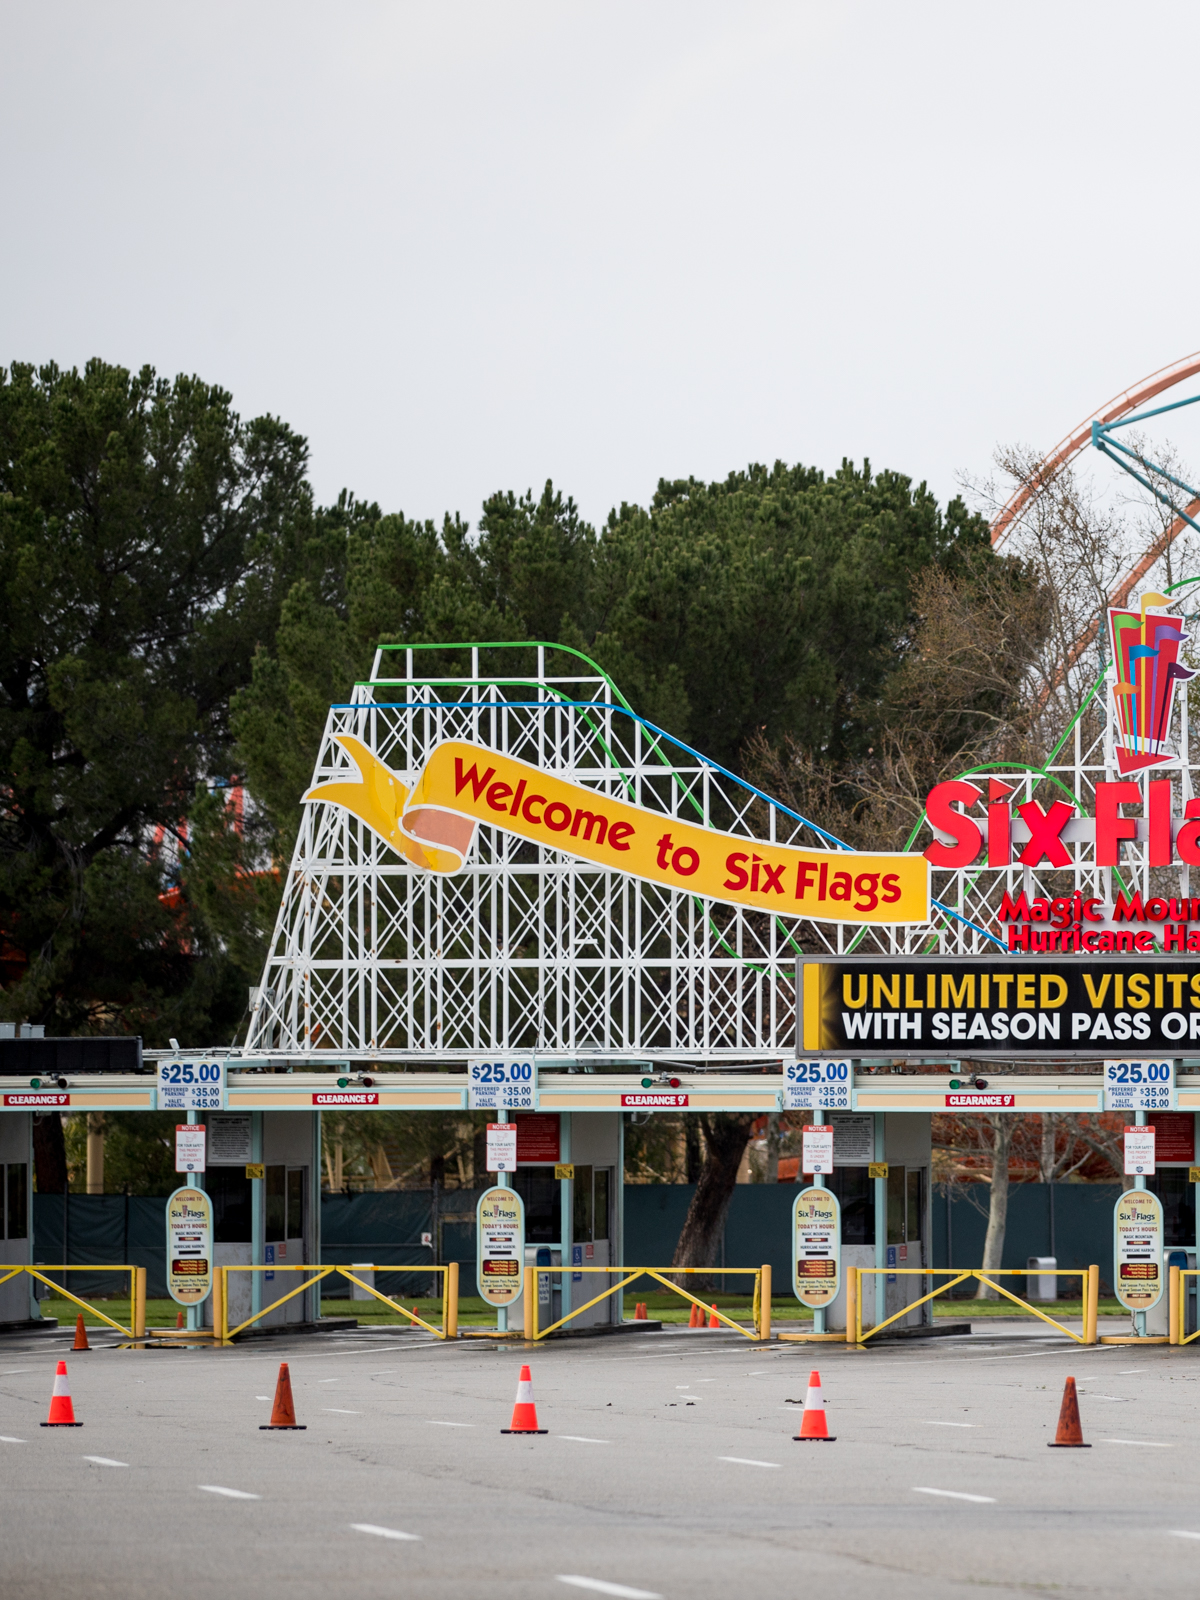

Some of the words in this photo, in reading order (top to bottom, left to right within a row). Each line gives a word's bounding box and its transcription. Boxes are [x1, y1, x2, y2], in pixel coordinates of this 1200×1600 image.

[923, 778, 1075, 868] Six
[455, 758, 635, 850] Welcome
[657, 834, 699, 875] to
[724, 853, 786, 894] Six
[796, 862, 901, 911] Flags
[998, 890, 1103, 929] Magic
[1007, 922, 1155, 952] Hurricane
[844, 975, 1067, 1008] UNLIMITED
[842, 1013, 921, 1039] WITH
[932, 1013, 1059, 1039] SEASON
[1072, 1013, 1150, 1039] PASS
[161, 1064, 220, 1083] $25.00
[472, 1063, 531, 1082] $25.00
[787, 1063, 848, 1082] $25.00
[1108, 1064, 1169, 1083] $25.00
[192, 1088, 219, 1096] $35.00
[503, 1087, 531, 1096] $35.00
[819, 1087, 847, 1096] $35.00
[1140, 1088, 1169, 1097] $35.00
[8, 1096, 57, 1104] CLEARANCE
[59, 1095, 66, 1104] 9'
[317, 1094, 366, 1103] CLEARANCE
[368, 1094, 375, 1103] 9'
[503, 1098, 531, 1107] $45.00
[625, 1096, 676, 1105] CLEARANCE
[678, 1095, 686, 1105] 9'
[819, 1098, 847, 1107] $45.00
[949, 1096, 1002, 1105] CLEARANCE
[1004, 1095, 1012, 1105] 9'
[192, 1099, 219, 1108] $45.00
[1140, 1099, 1169, 1108] $45.00
[187, 1210, 205, 1218] Flags
[499, 1210, 516, 1218] Flags
[814, 1210, 832, 1218] Flags
[1137, 1213, 1155, 1221] Flags
